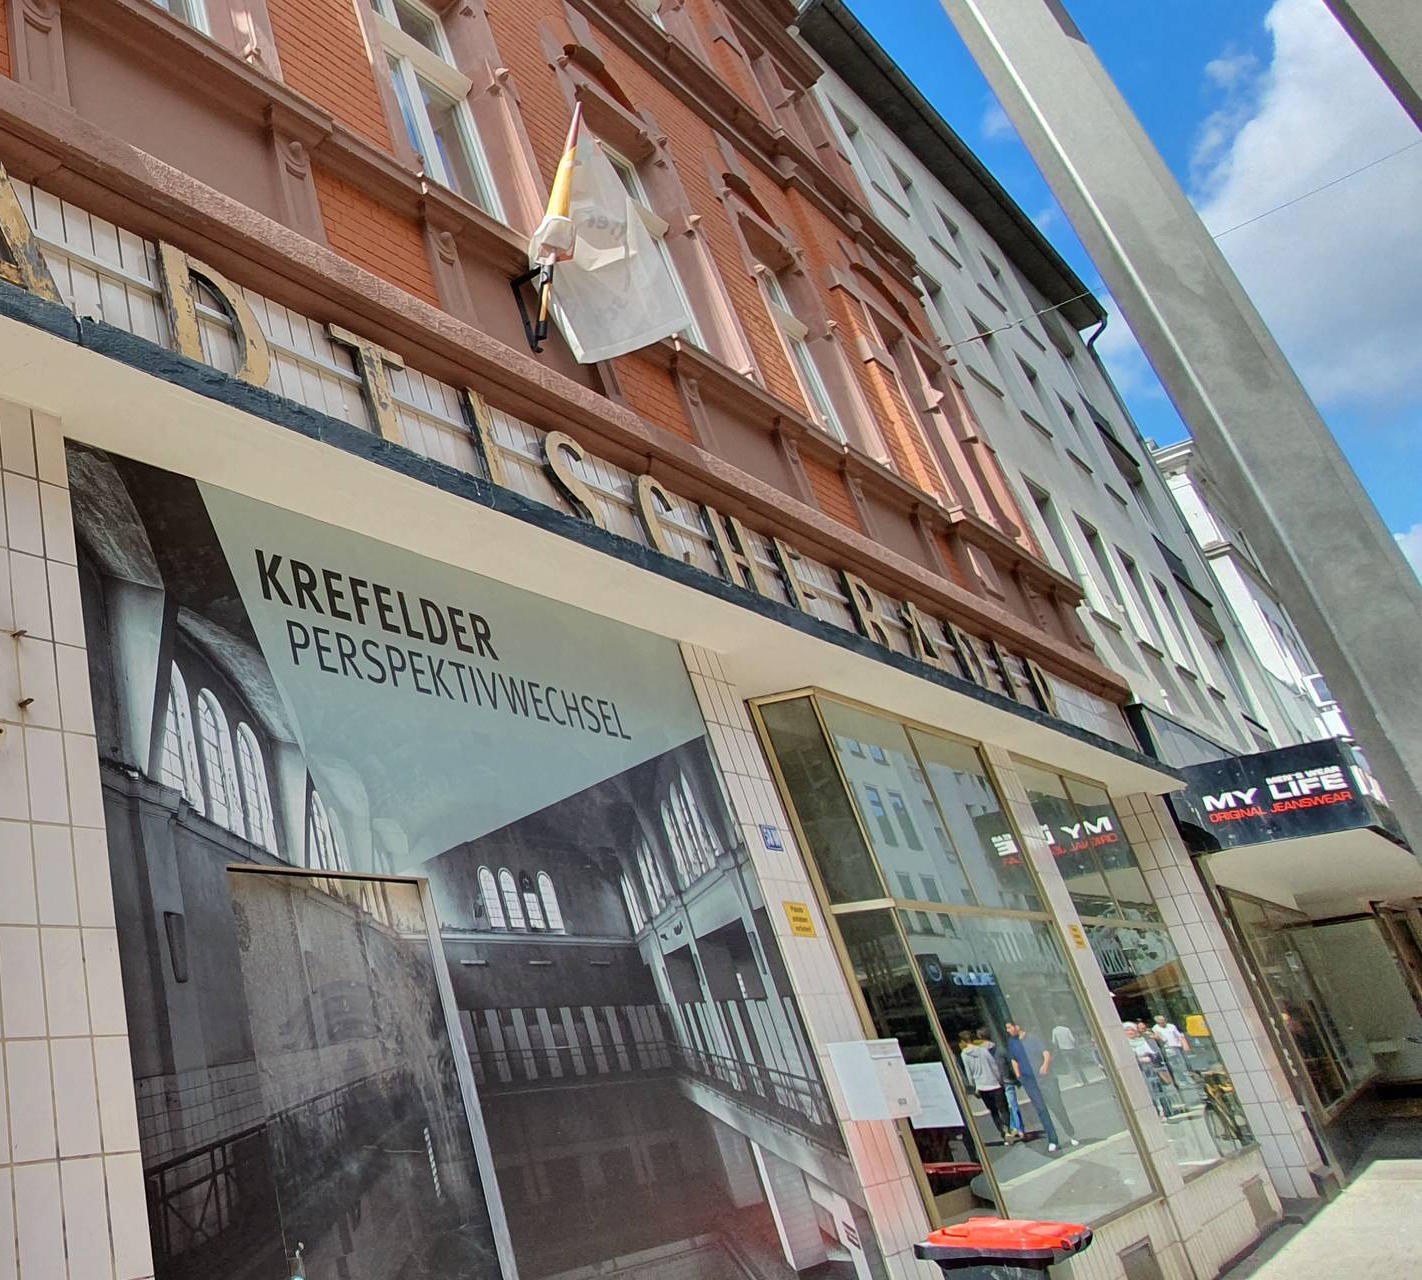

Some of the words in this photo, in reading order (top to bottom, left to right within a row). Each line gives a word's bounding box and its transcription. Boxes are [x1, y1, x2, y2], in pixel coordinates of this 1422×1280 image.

[255, 548, 500, 661] KREFELDER
[285, 619, 632, 741] PERSPEKTIVWECHSEL
[1202, 787, 1259, 812] MY
[1268, 773, 1349, 801] LIFE
[1209, 805, 1268, 824] ORIGINAL
[1270, 791, 1353, 814] JEANSWEAR
